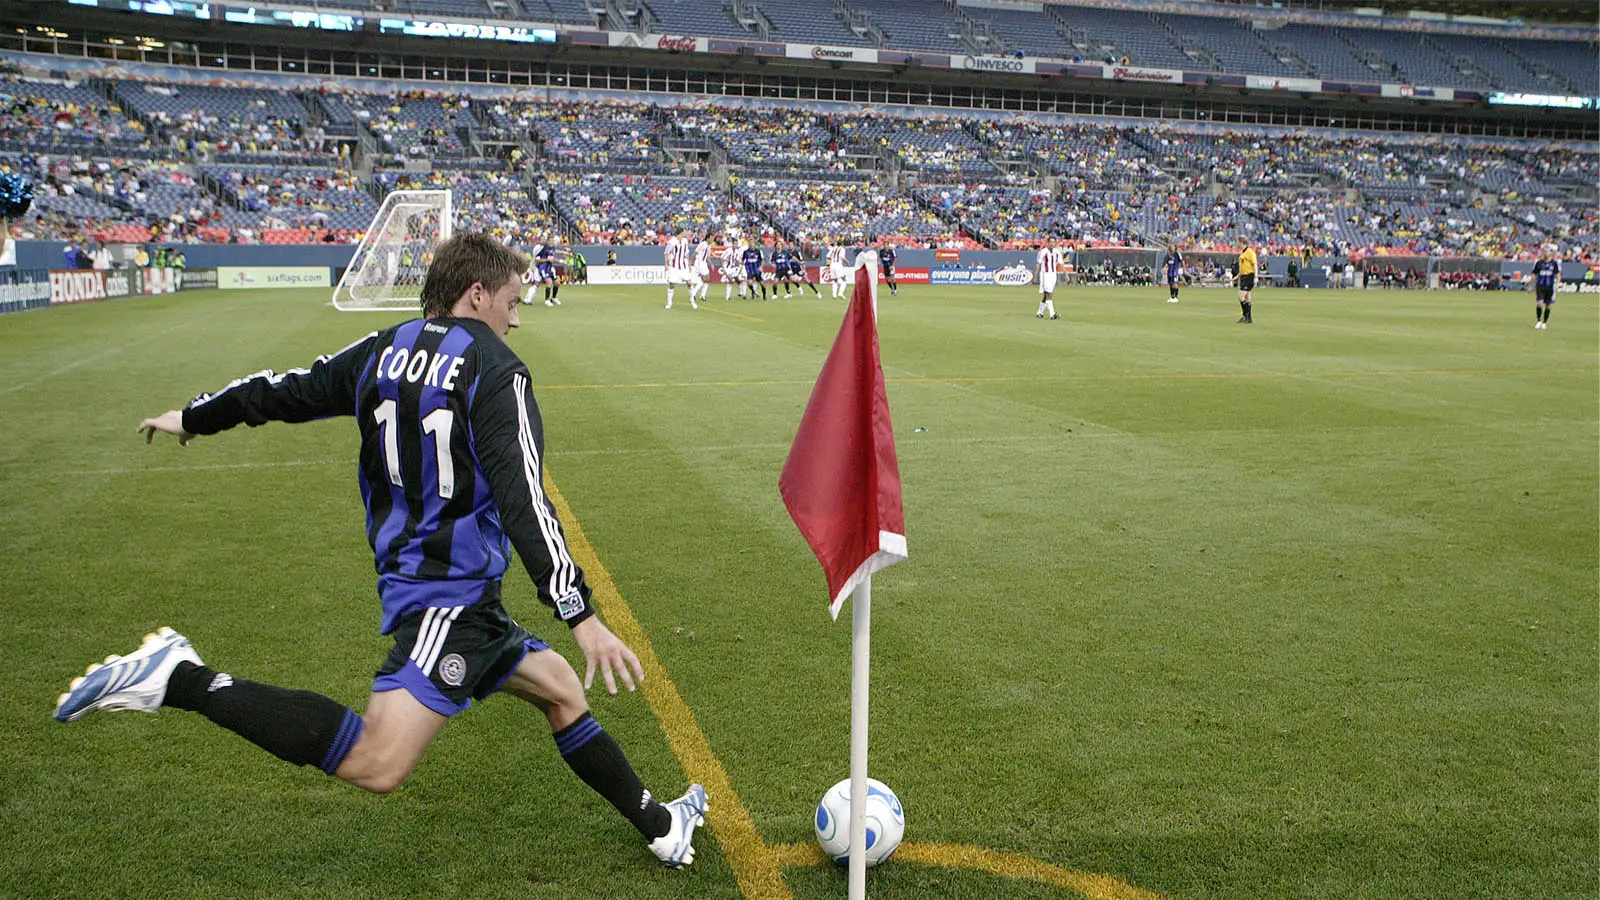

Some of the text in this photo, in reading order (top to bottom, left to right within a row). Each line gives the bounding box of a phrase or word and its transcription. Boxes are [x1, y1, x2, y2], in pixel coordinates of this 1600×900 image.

[811, 46, 854, 60] Comcast
[976, 58, 1024, 71] INVESCO
[1112, 67, 1173, 80] Budweiser
[266, 272, 323, 284] sixflags.com
[624, 267, 667, 283] cingul
[932, 270, 970, 281] everyone
[49, 271, 106, 302] HONDA
[376, 346, 465, 391] COOKE
[373, 399, 455, 500] 11
